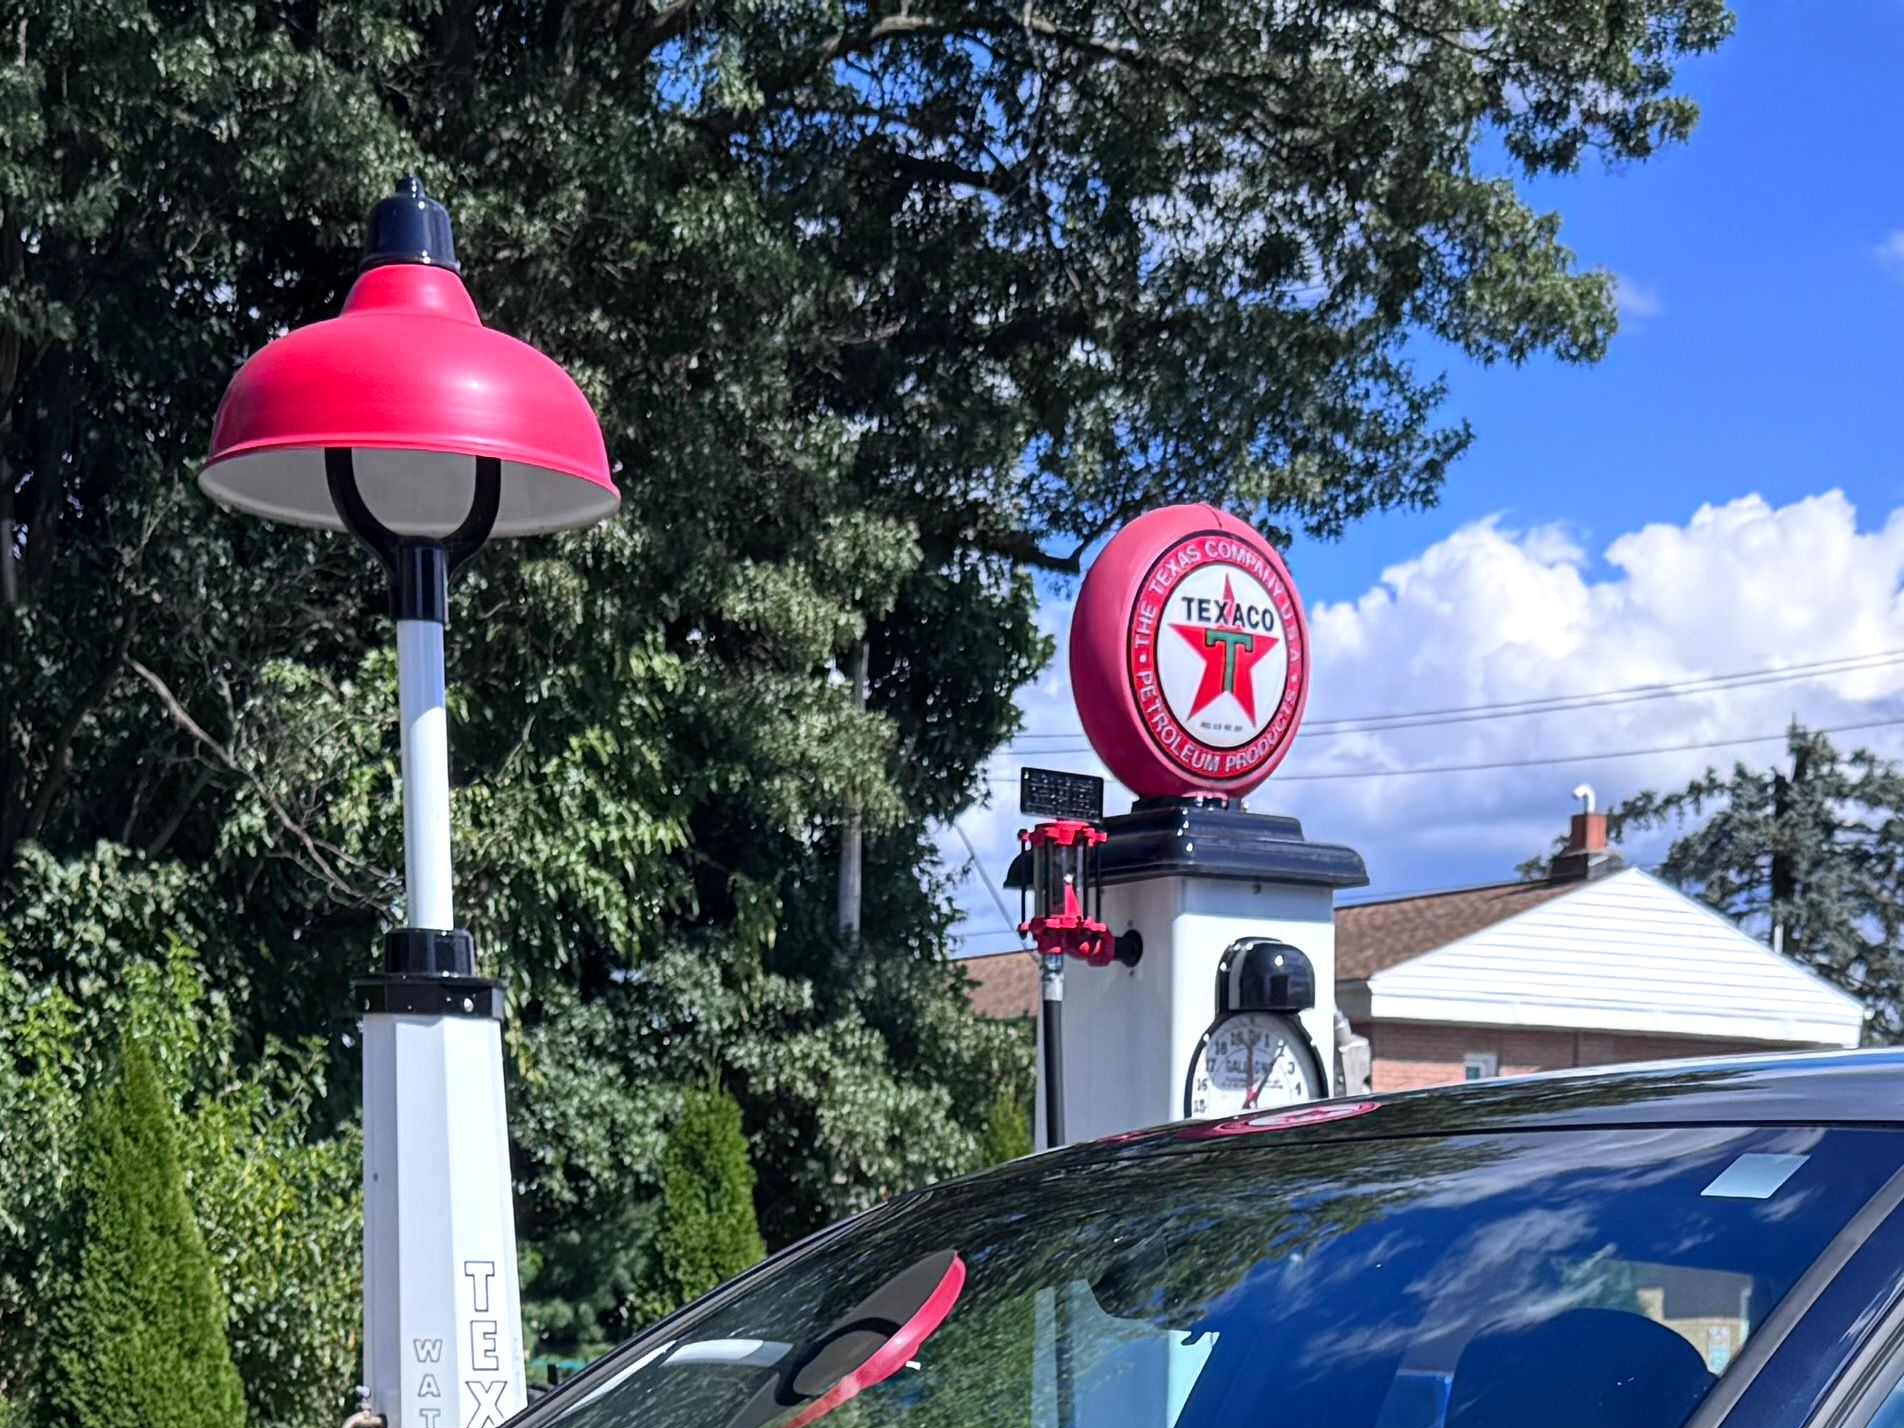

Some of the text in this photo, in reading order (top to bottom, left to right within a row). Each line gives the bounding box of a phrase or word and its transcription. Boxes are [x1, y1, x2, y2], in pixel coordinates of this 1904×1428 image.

[1134, 603, 1156, 649] THE
[1147, 545, 1202, 594] TEXAS
[1204, 540, 1284, 600] COMPANY
[1181, 595, 1276, 633] TEXACO
[1205, 628, 1254, 694] T
[1136, 673, 1297, 773] PETROLEUM PRODUCTS
